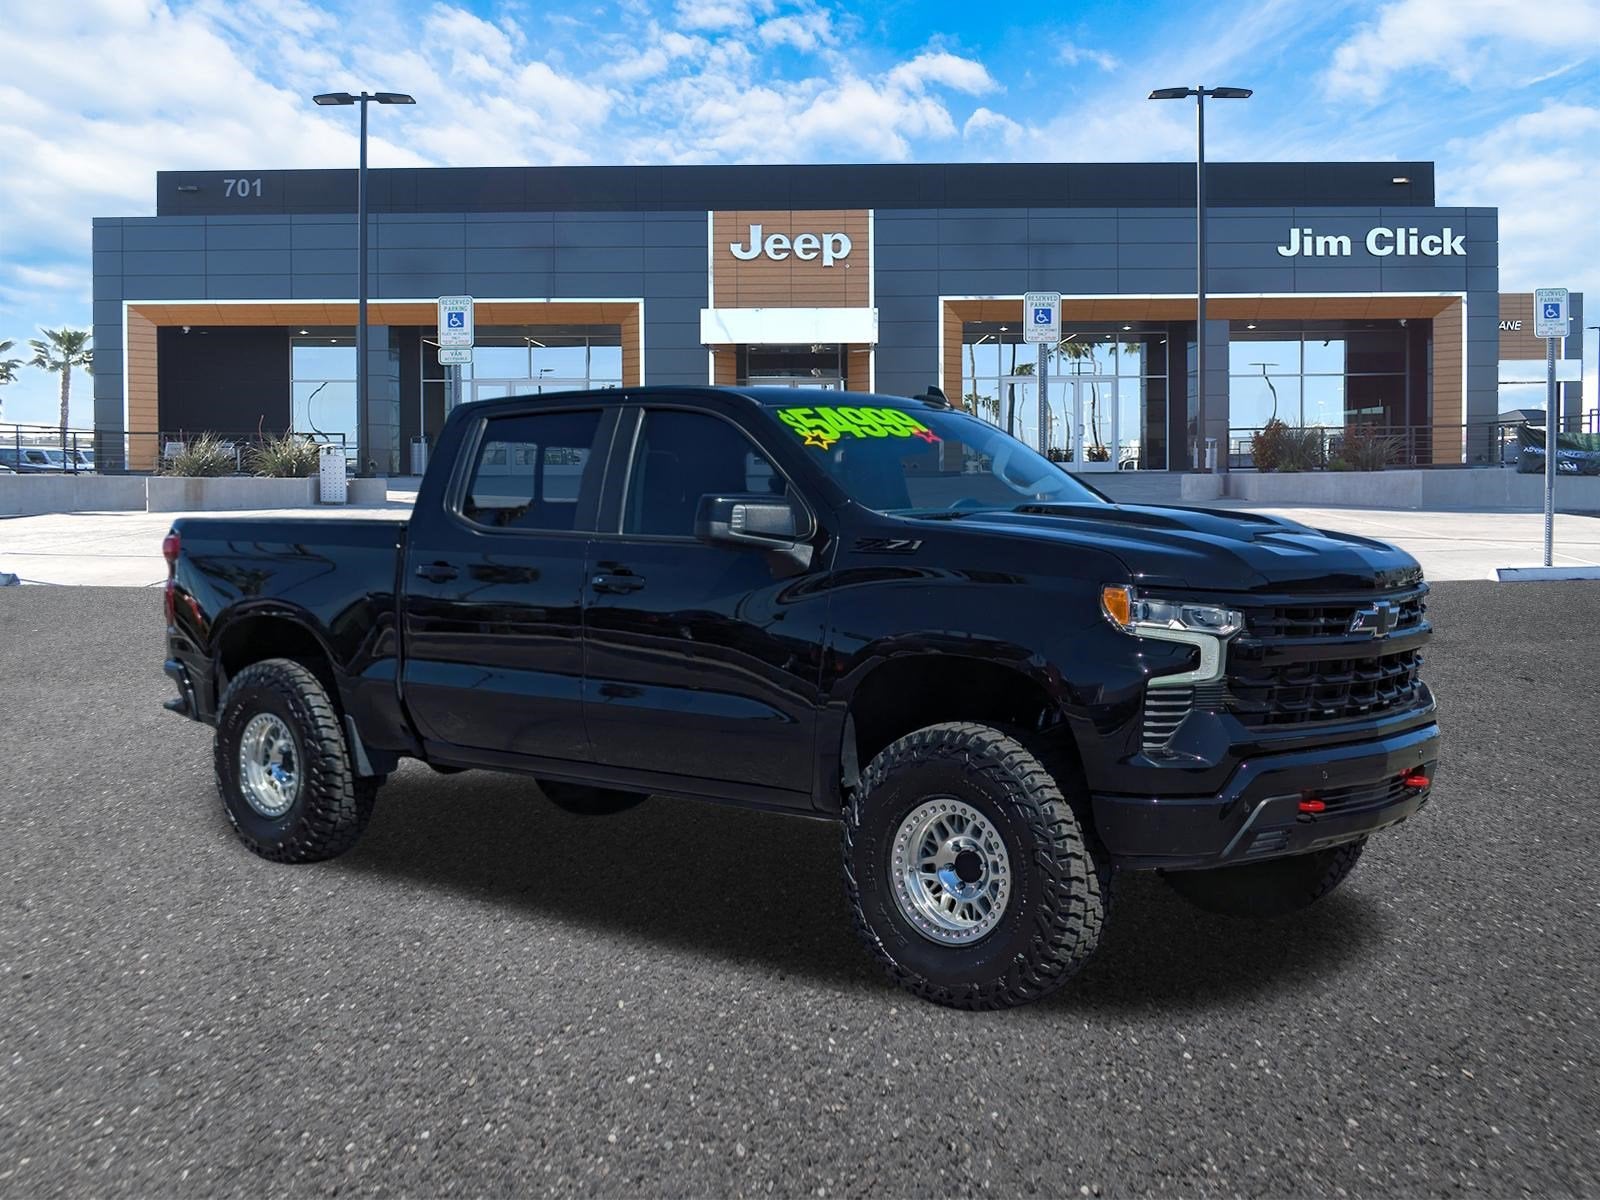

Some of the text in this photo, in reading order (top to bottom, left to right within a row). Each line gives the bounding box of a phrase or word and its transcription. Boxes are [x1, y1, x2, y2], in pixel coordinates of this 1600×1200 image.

[223, 178, 262, 198] 701
[730, 224, 852, 268] Jeep
[1277, 227, 1467, 257] Jim Click
[1498, 320, 1522, 331] ANE
